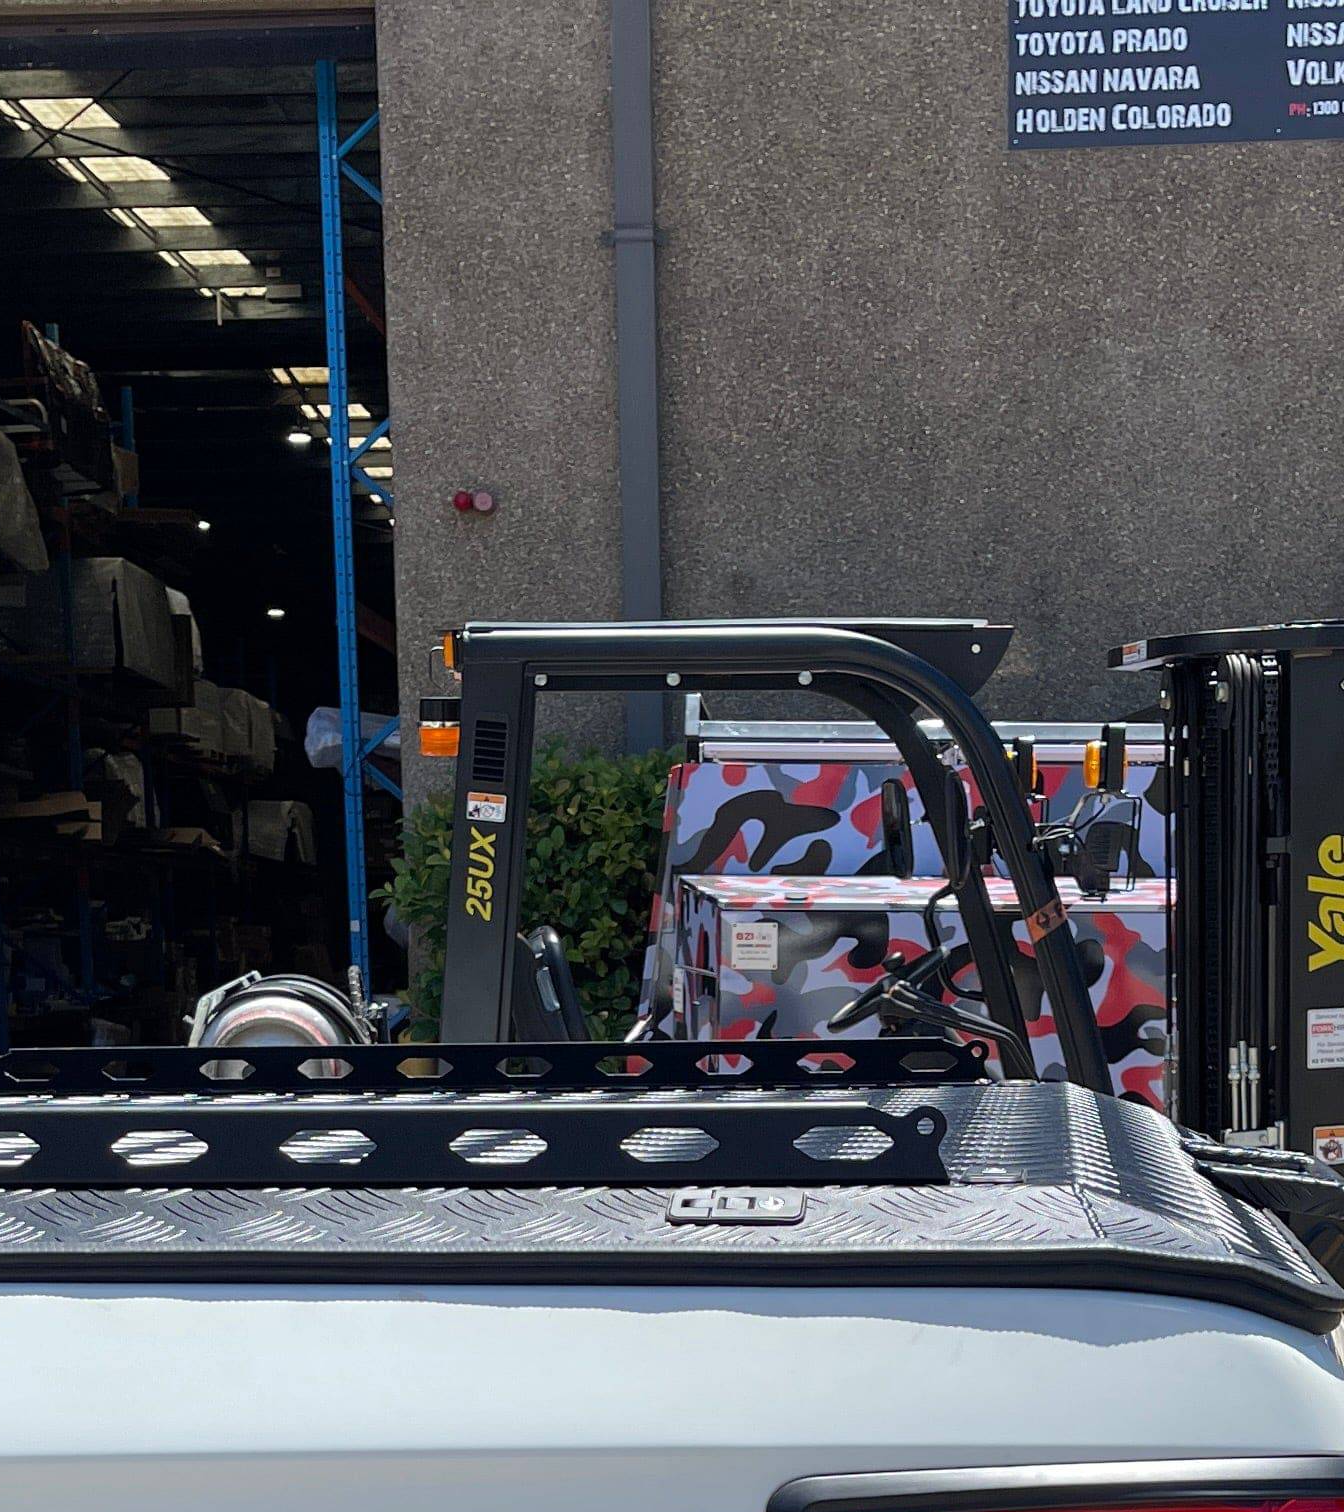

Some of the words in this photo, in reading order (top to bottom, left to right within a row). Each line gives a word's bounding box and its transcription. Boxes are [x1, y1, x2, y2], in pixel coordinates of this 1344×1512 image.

[1017, 0, 1105, 18] TOYOTA
[1111, 0, 1172, 15] LAND
[1016, 30, 1105, 56] TOYOTA
[1112, 27, 1188, 53] PRADO
[1015, 69, 1097, 95] NISSAN
[1103, 65, 1200, 92] NAVARA
[1016, 107, 1106, 133] HOLDEN
[1111, 103, 1232, 130] COLORADO
[1313, 99, 1338, 115] 1300
[465, 826, 496, 922] 25UX
